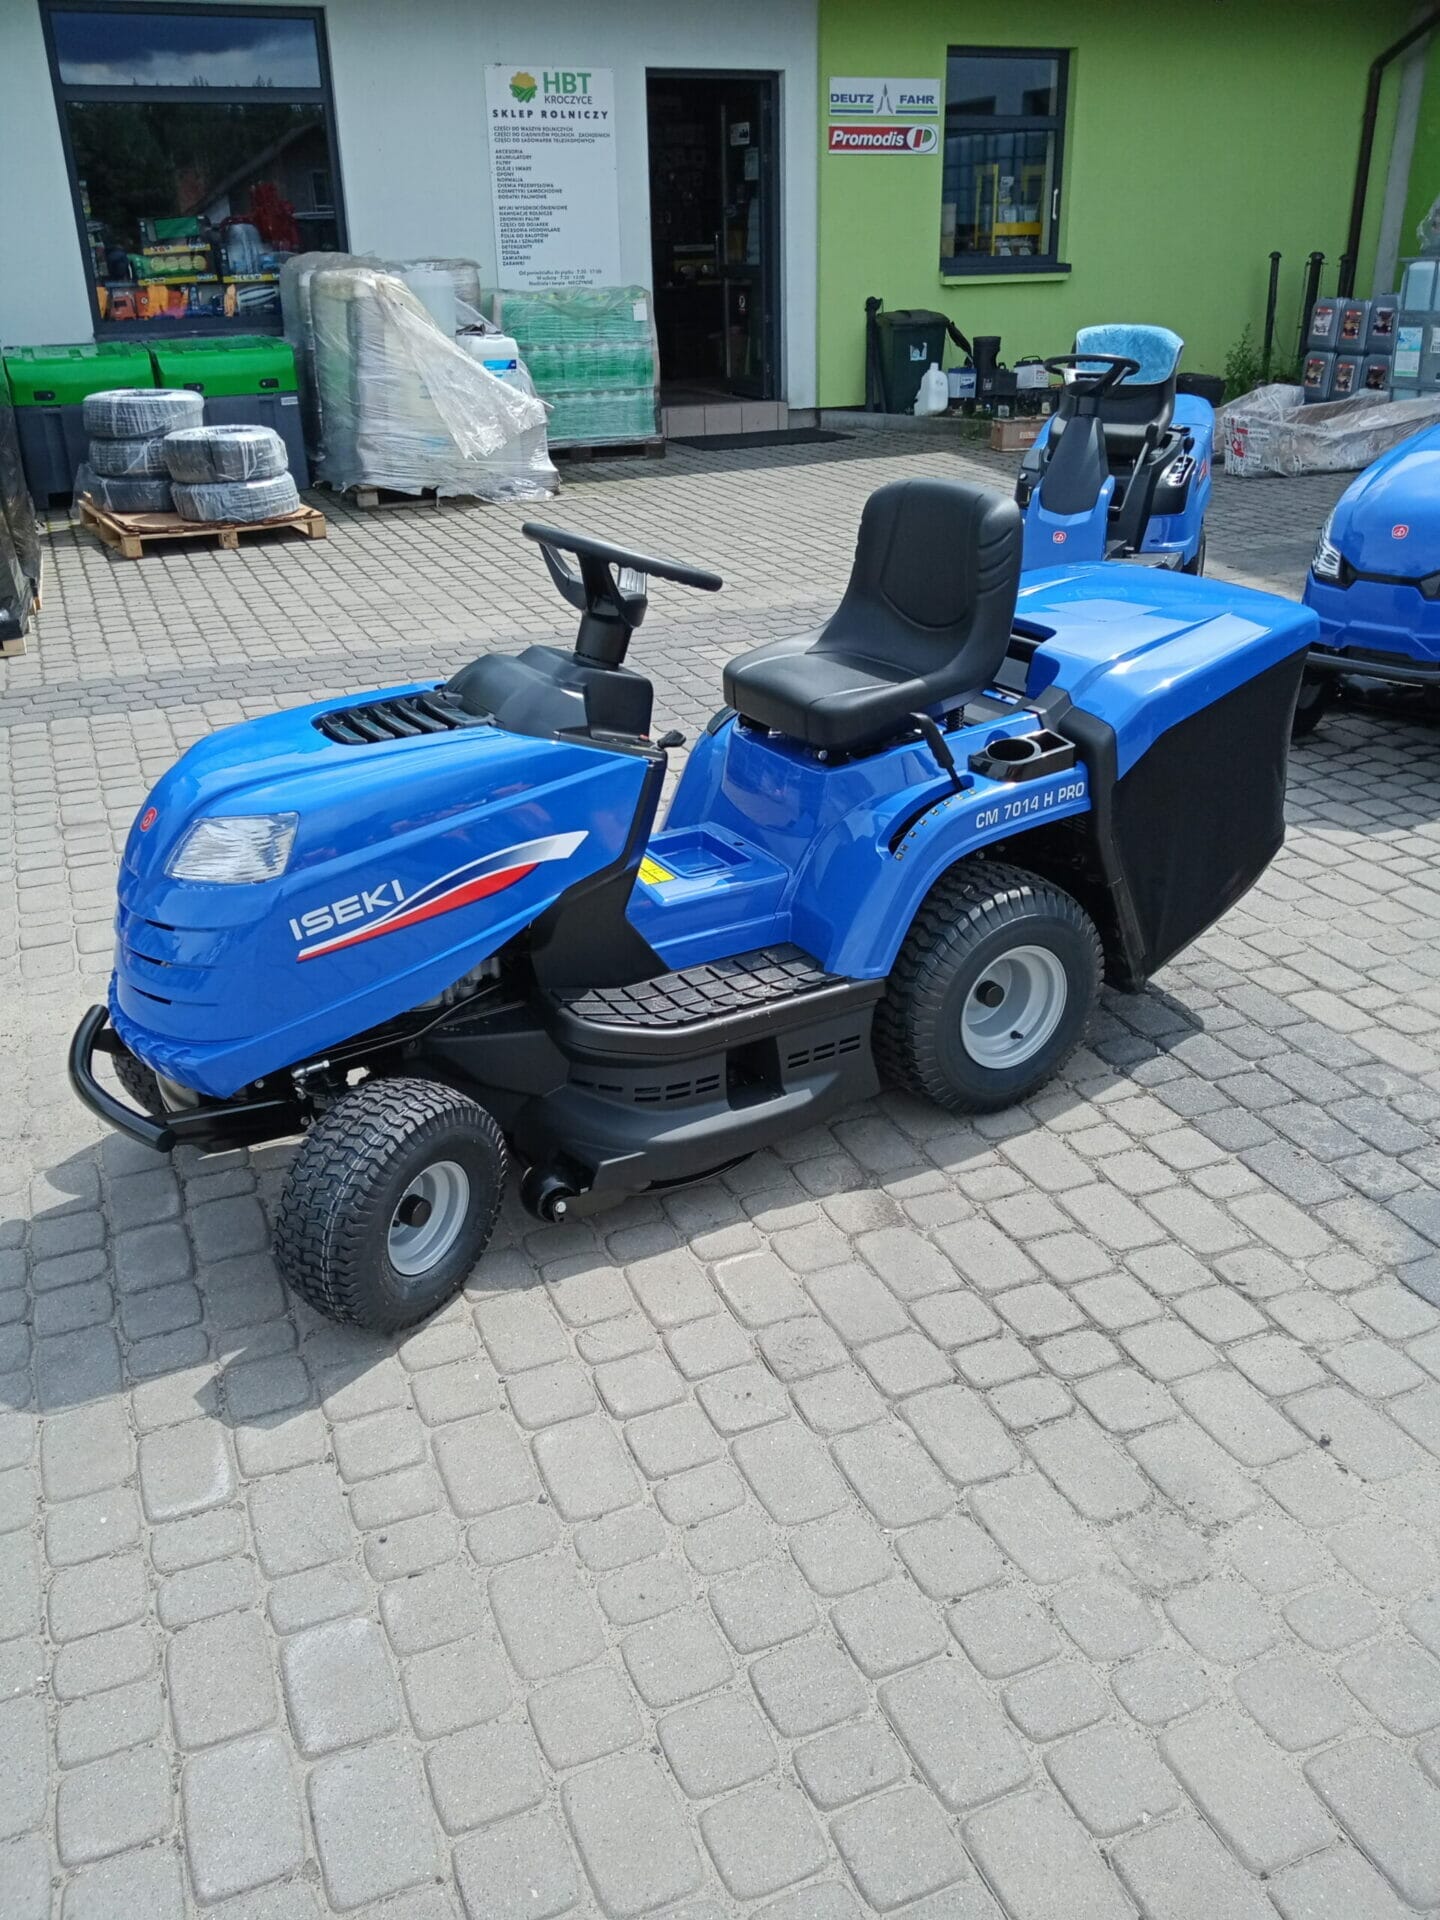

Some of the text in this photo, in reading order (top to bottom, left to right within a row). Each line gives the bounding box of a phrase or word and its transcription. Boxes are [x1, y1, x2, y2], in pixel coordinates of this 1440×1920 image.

[543, 72, 591, 94] HBT
[544, 95, 592, 105] KROCZYCE
[830, 94, 934, 104] DEUTZ FAHR
[492, 109, 608, 119] SKLEP ROLNICZY
[832, 130, 904, 146] Promodis
[976, 782, 1085, 829] CM 7014 H PRO
[288, 879, 406, 941] ISEKI
